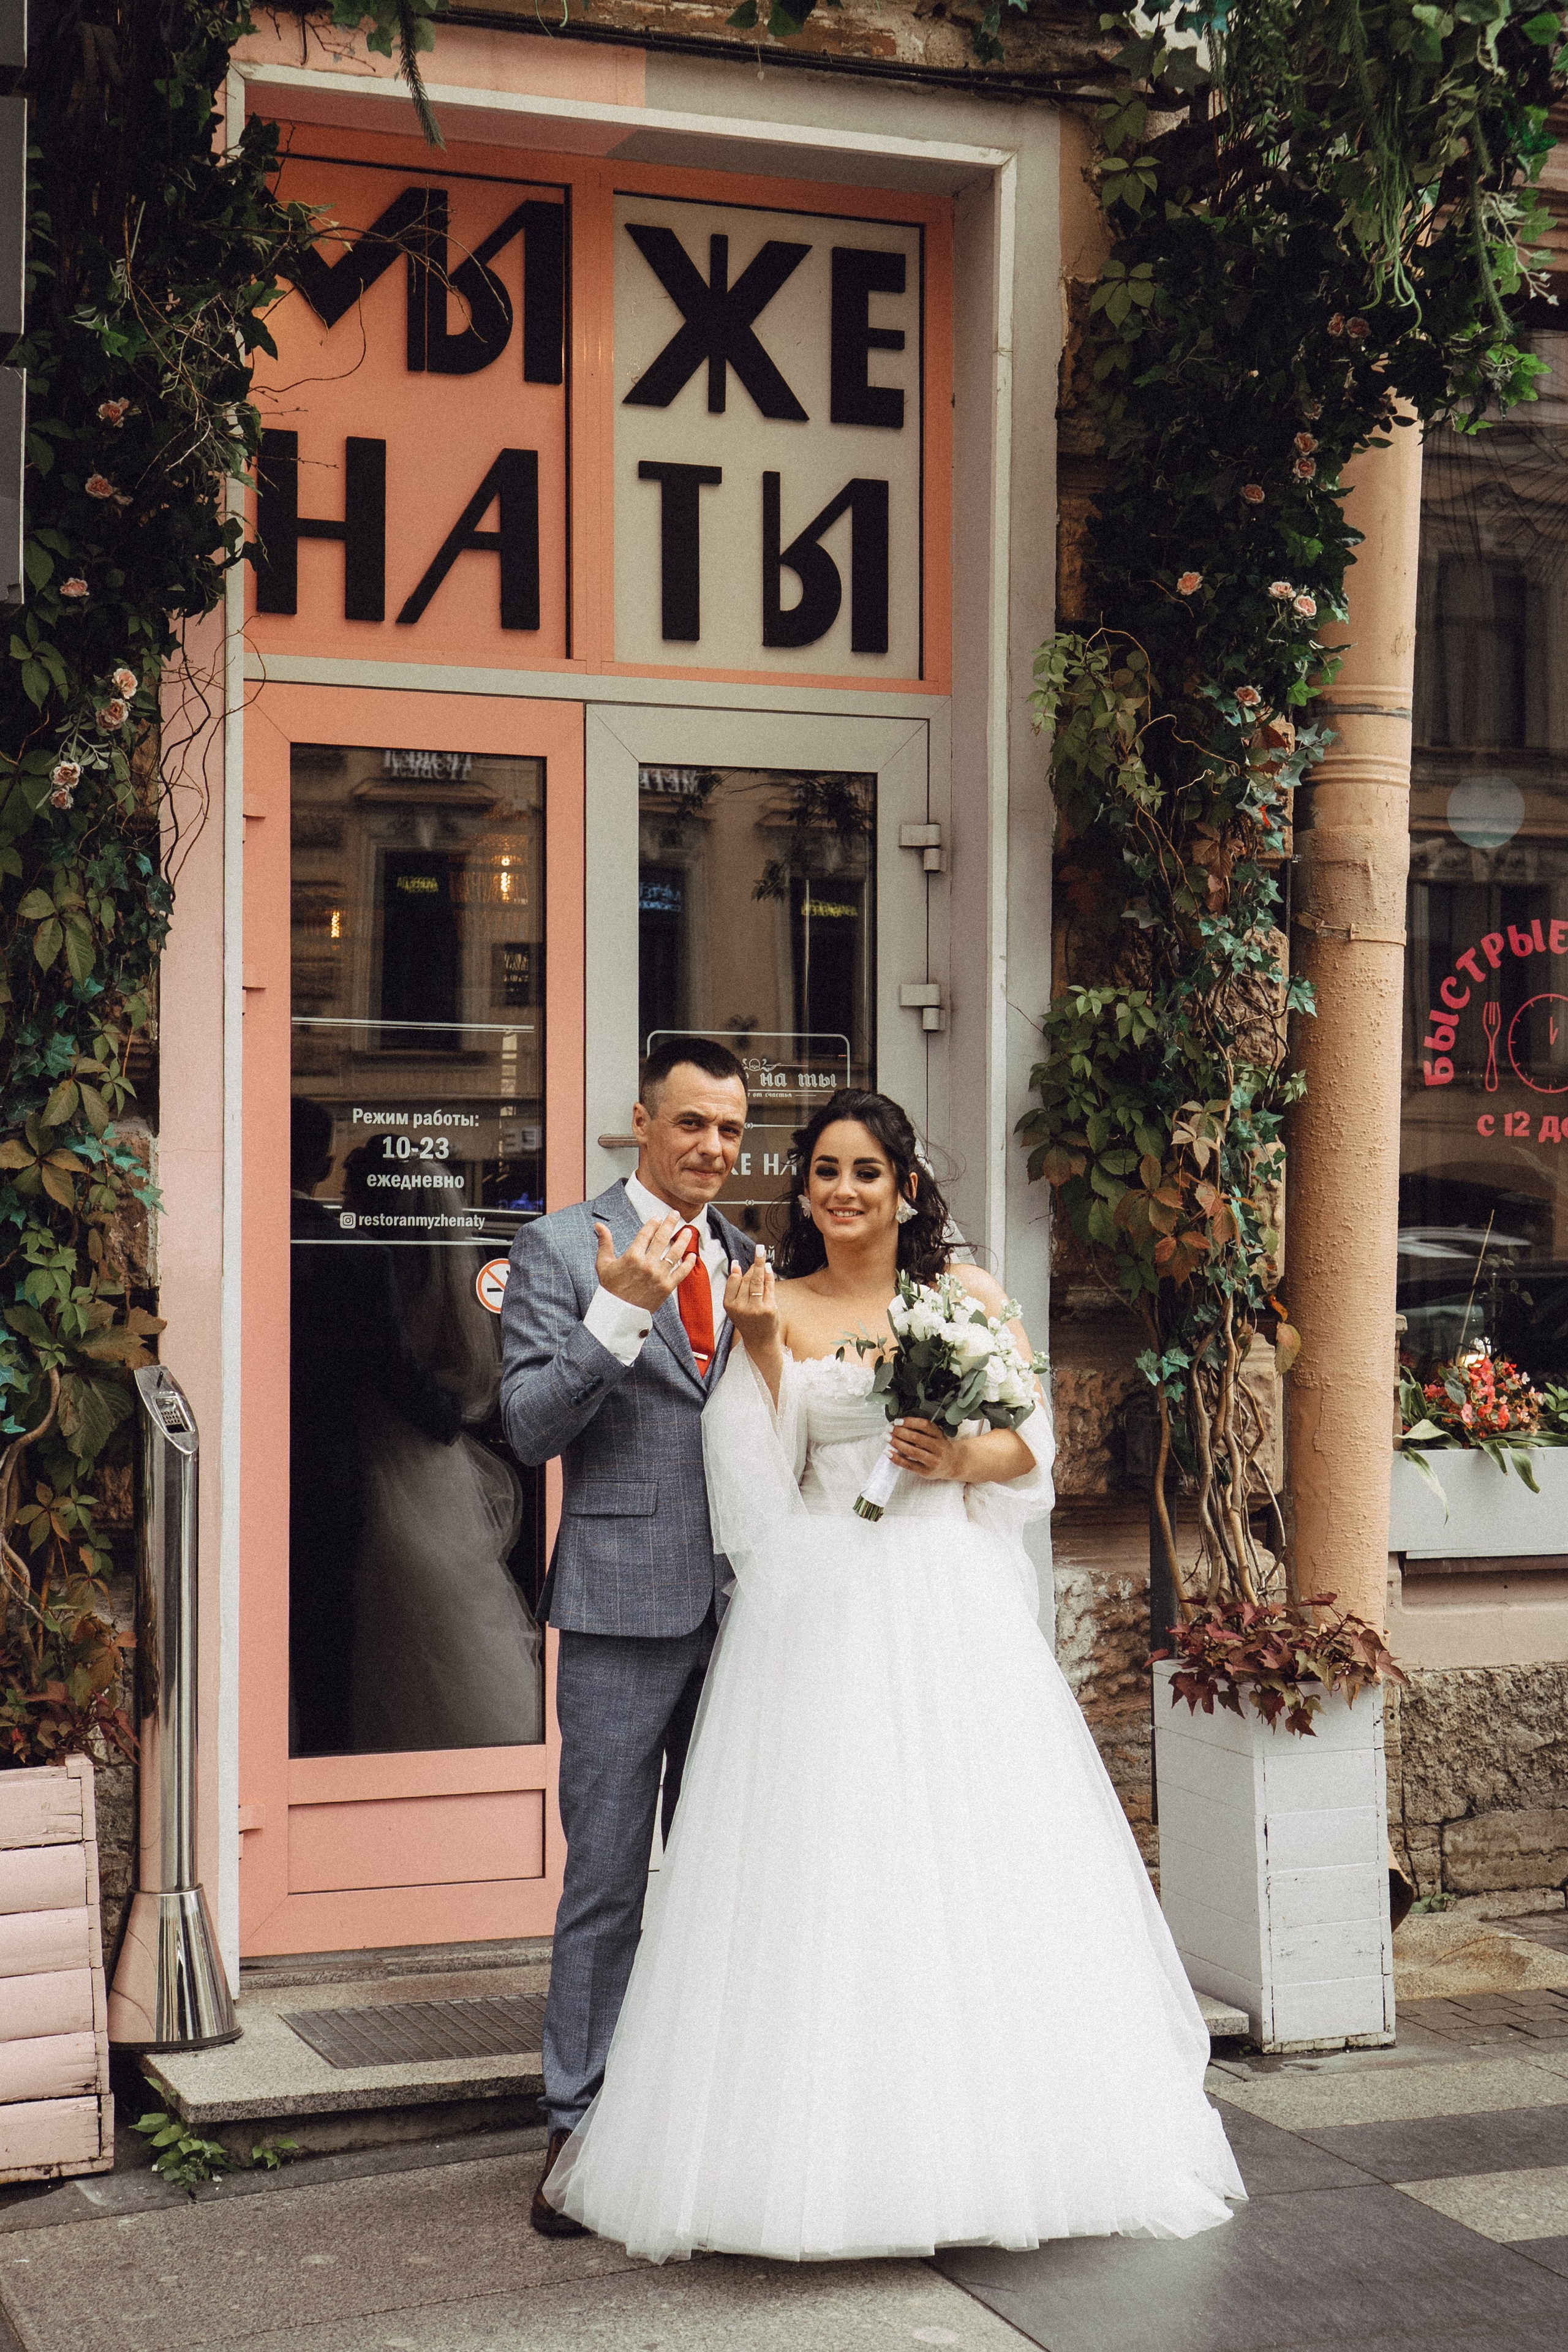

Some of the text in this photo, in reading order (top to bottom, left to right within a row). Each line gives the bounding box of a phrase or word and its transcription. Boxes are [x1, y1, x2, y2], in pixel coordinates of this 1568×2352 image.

[622, 223, 907, 429] ЖЕ
[256, 428, 890, 654] НА ТЫ
[760, 1072, 787, 1087] на
[797, 1073, 837, 1088] ты
[353, 1108, 480, 1128] Режим работы:
[1504, 1111, 1531, 1137] 12
[382, 1136, 450, 1159] 10-23
[367, 1174, 465, 1189] ежедневно
[358, 1213, 486, 1229] restoranmyzhenaty
